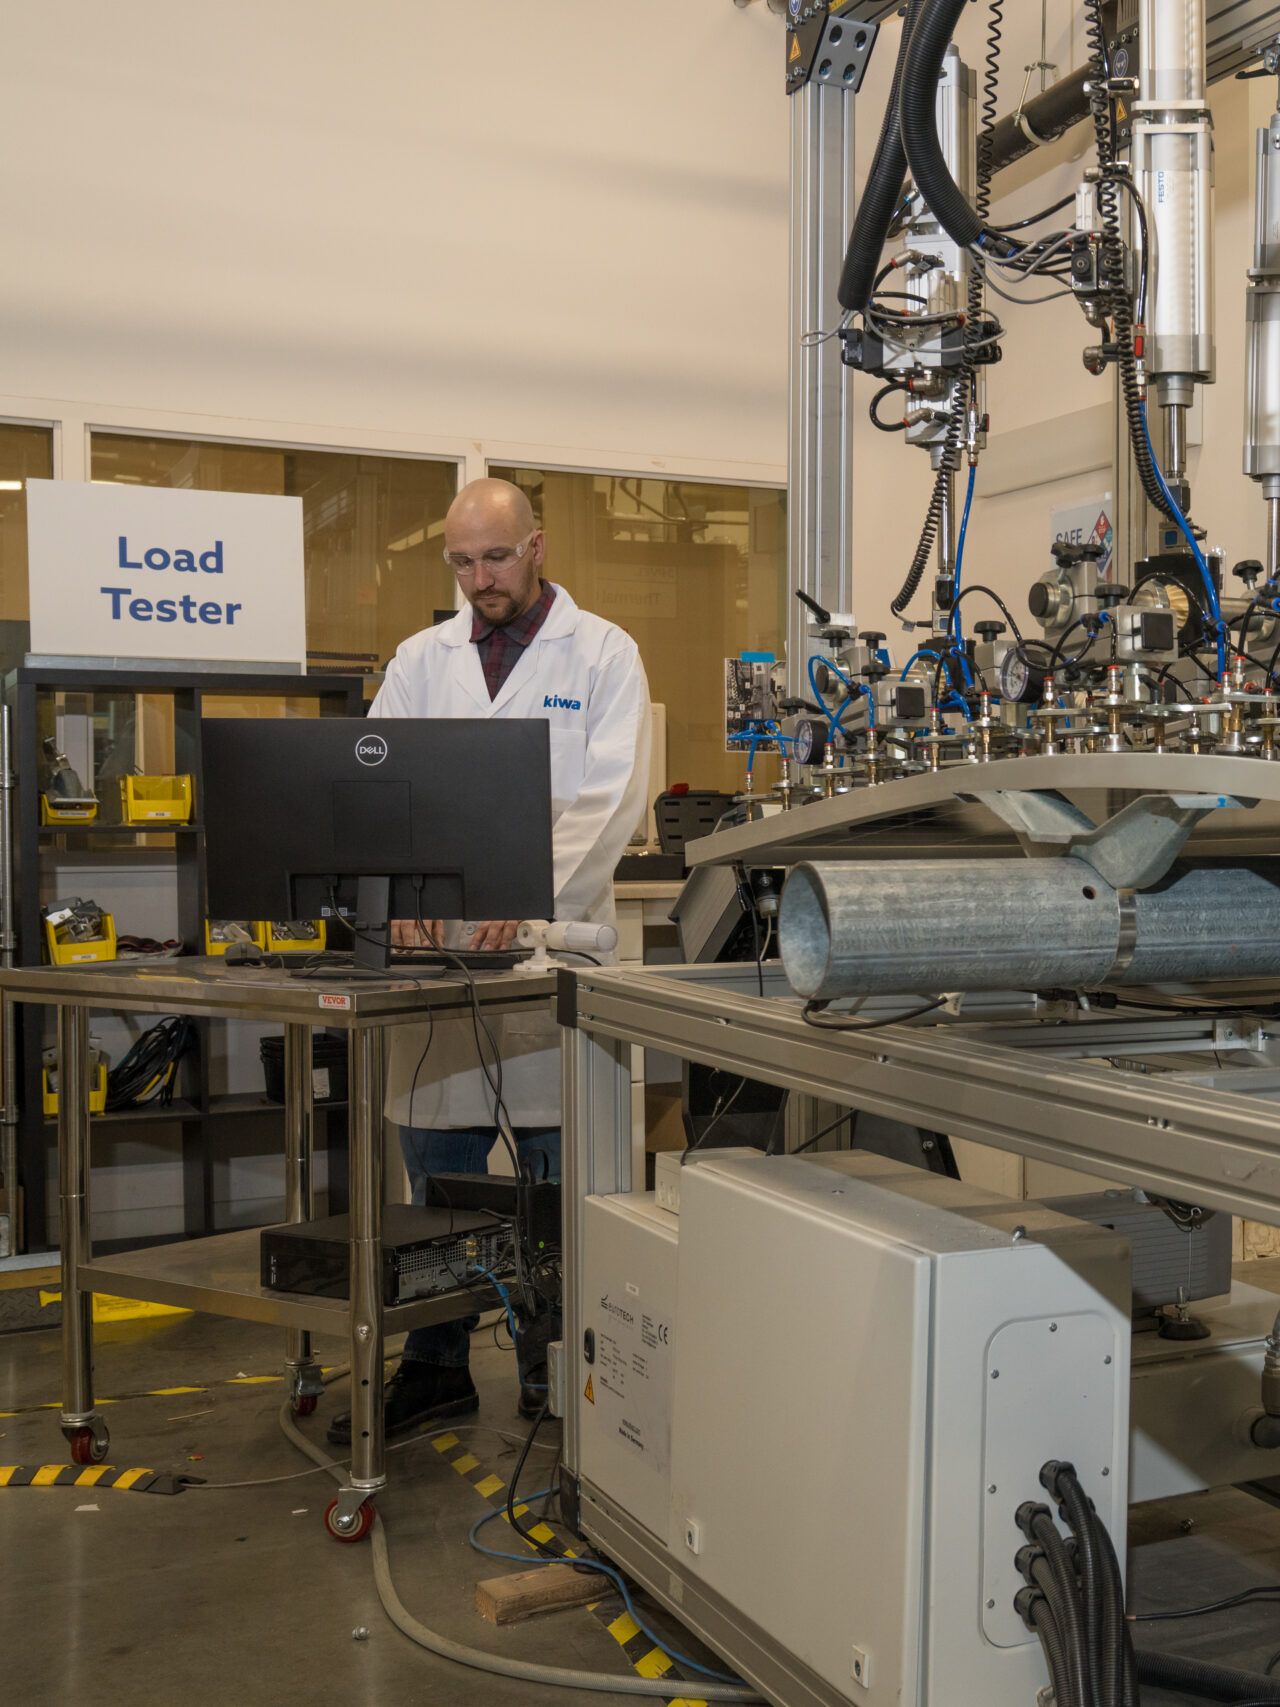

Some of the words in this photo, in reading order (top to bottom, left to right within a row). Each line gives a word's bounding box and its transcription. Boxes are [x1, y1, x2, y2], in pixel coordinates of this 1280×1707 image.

[118, 535, 223, 573] Load
[100, 587, 242, 625] Tester
[543, 694, 581, 710] kiwa
[359, 746, 384, 755] DELL
[322, 996, 346, 1005] VEVOR
